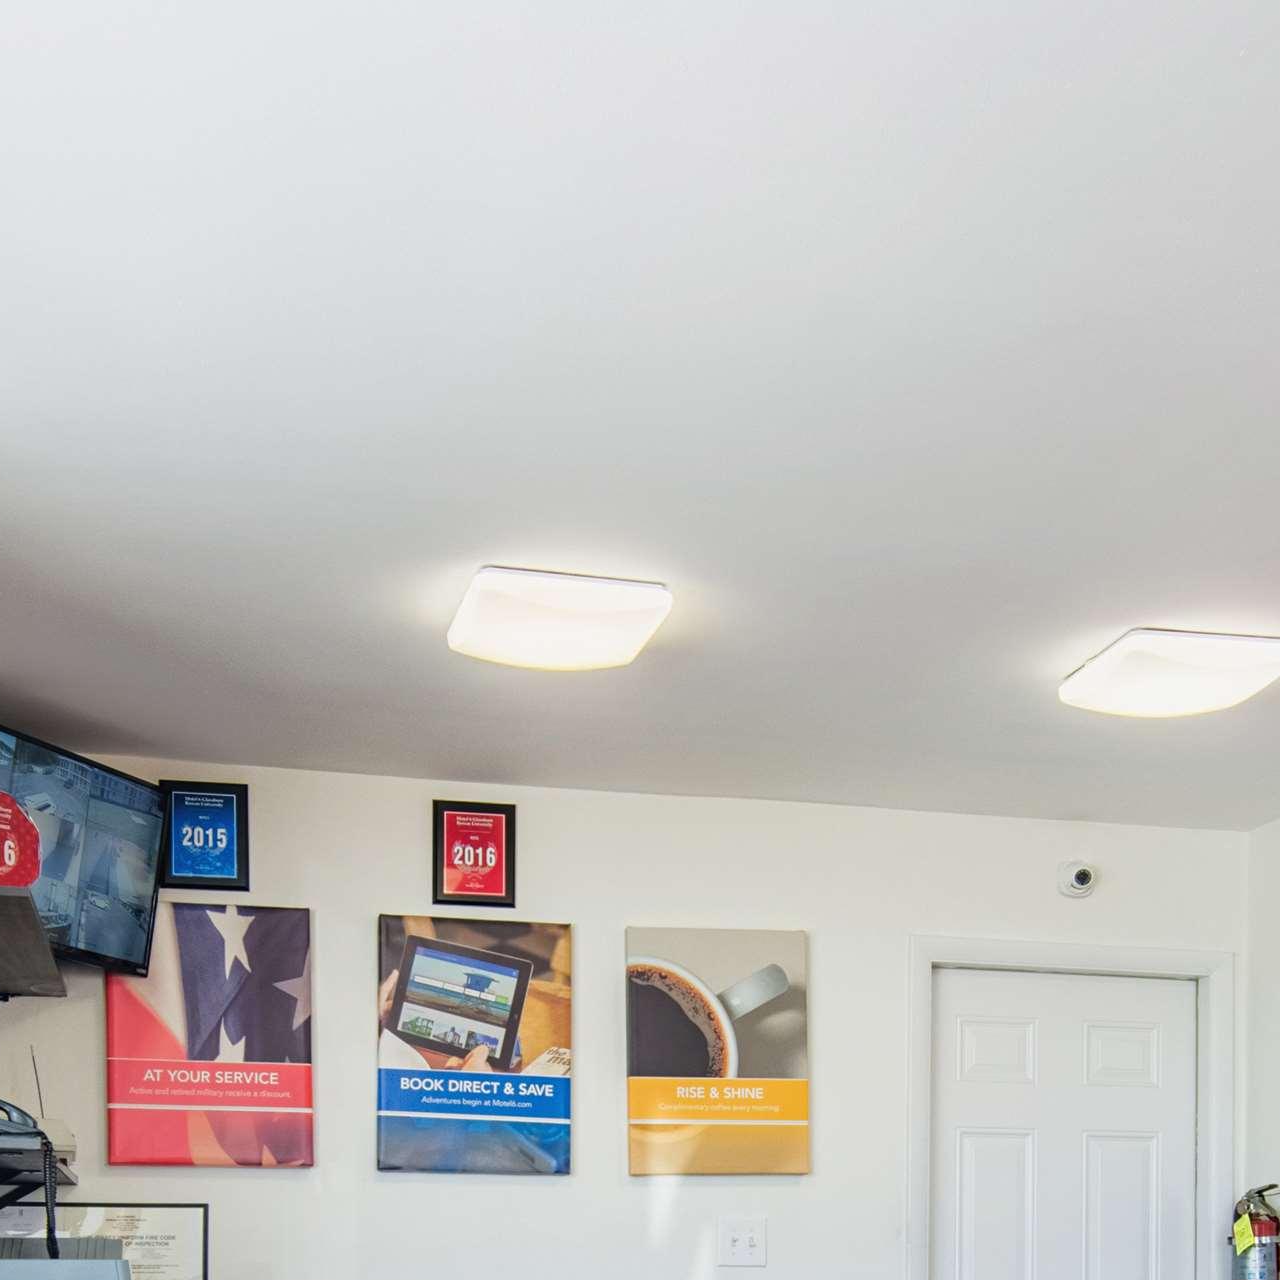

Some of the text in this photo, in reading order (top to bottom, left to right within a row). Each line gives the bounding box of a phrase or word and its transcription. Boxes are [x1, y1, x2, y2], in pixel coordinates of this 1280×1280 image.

[182, 826, 227, 848] 2015
[453, 845, 496, 867] 2016
[144, 1068, 279, 1085] AT YOUR SERVICE
[154, 1088, 169, 1096] and
[196, 1088, 225, 1098] military
[225, 1090, 252, 1098] receive
[400, 1077, 554, 1097] BOOK DIRECT & SAVE
[676, 1086, 764, 1099] RISE & SHINE
[421, 1095, 533, 1109] Adventures begin at Motel6.com
